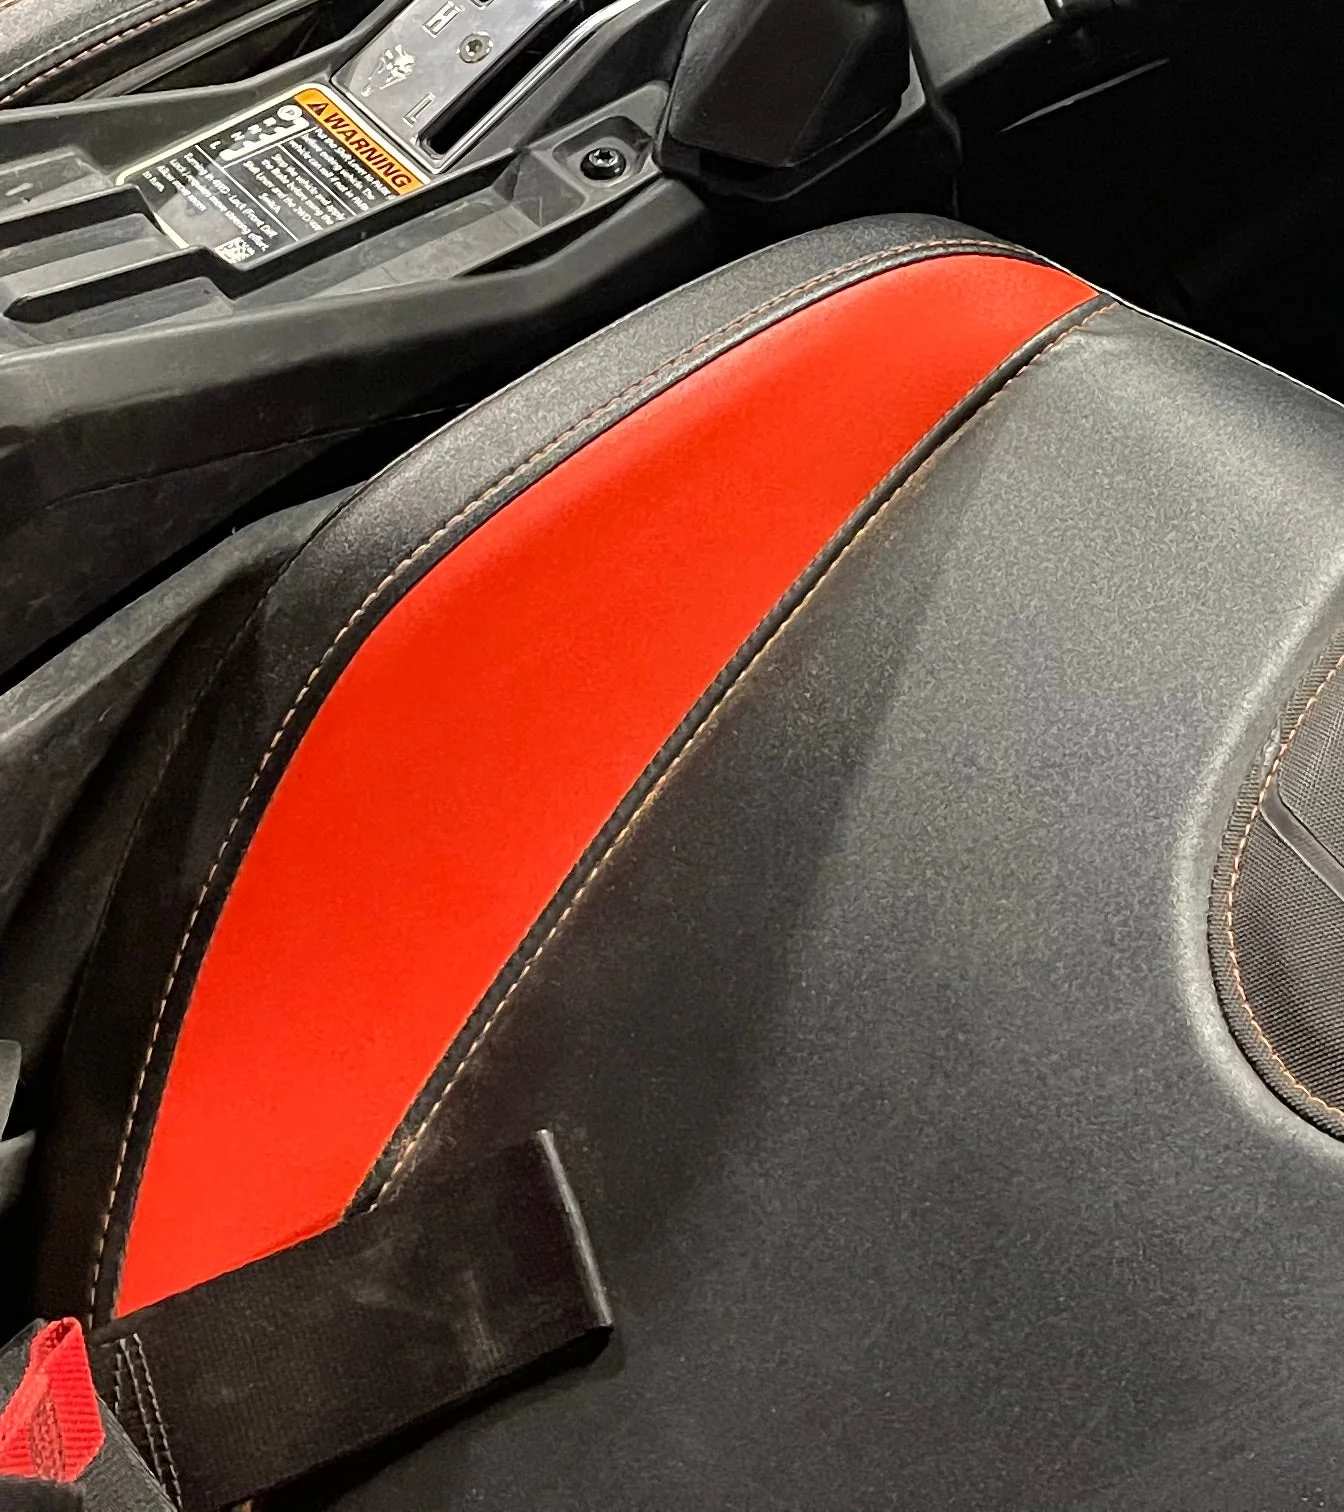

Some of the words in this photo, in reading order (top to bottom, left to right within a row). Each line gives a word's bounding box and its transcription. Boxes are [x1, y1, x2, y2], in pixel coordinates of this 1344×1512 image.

[422, 0, 465, 38] H
[402, 92, 436, 128] L
[323, 112, 412, 190] WARNING
